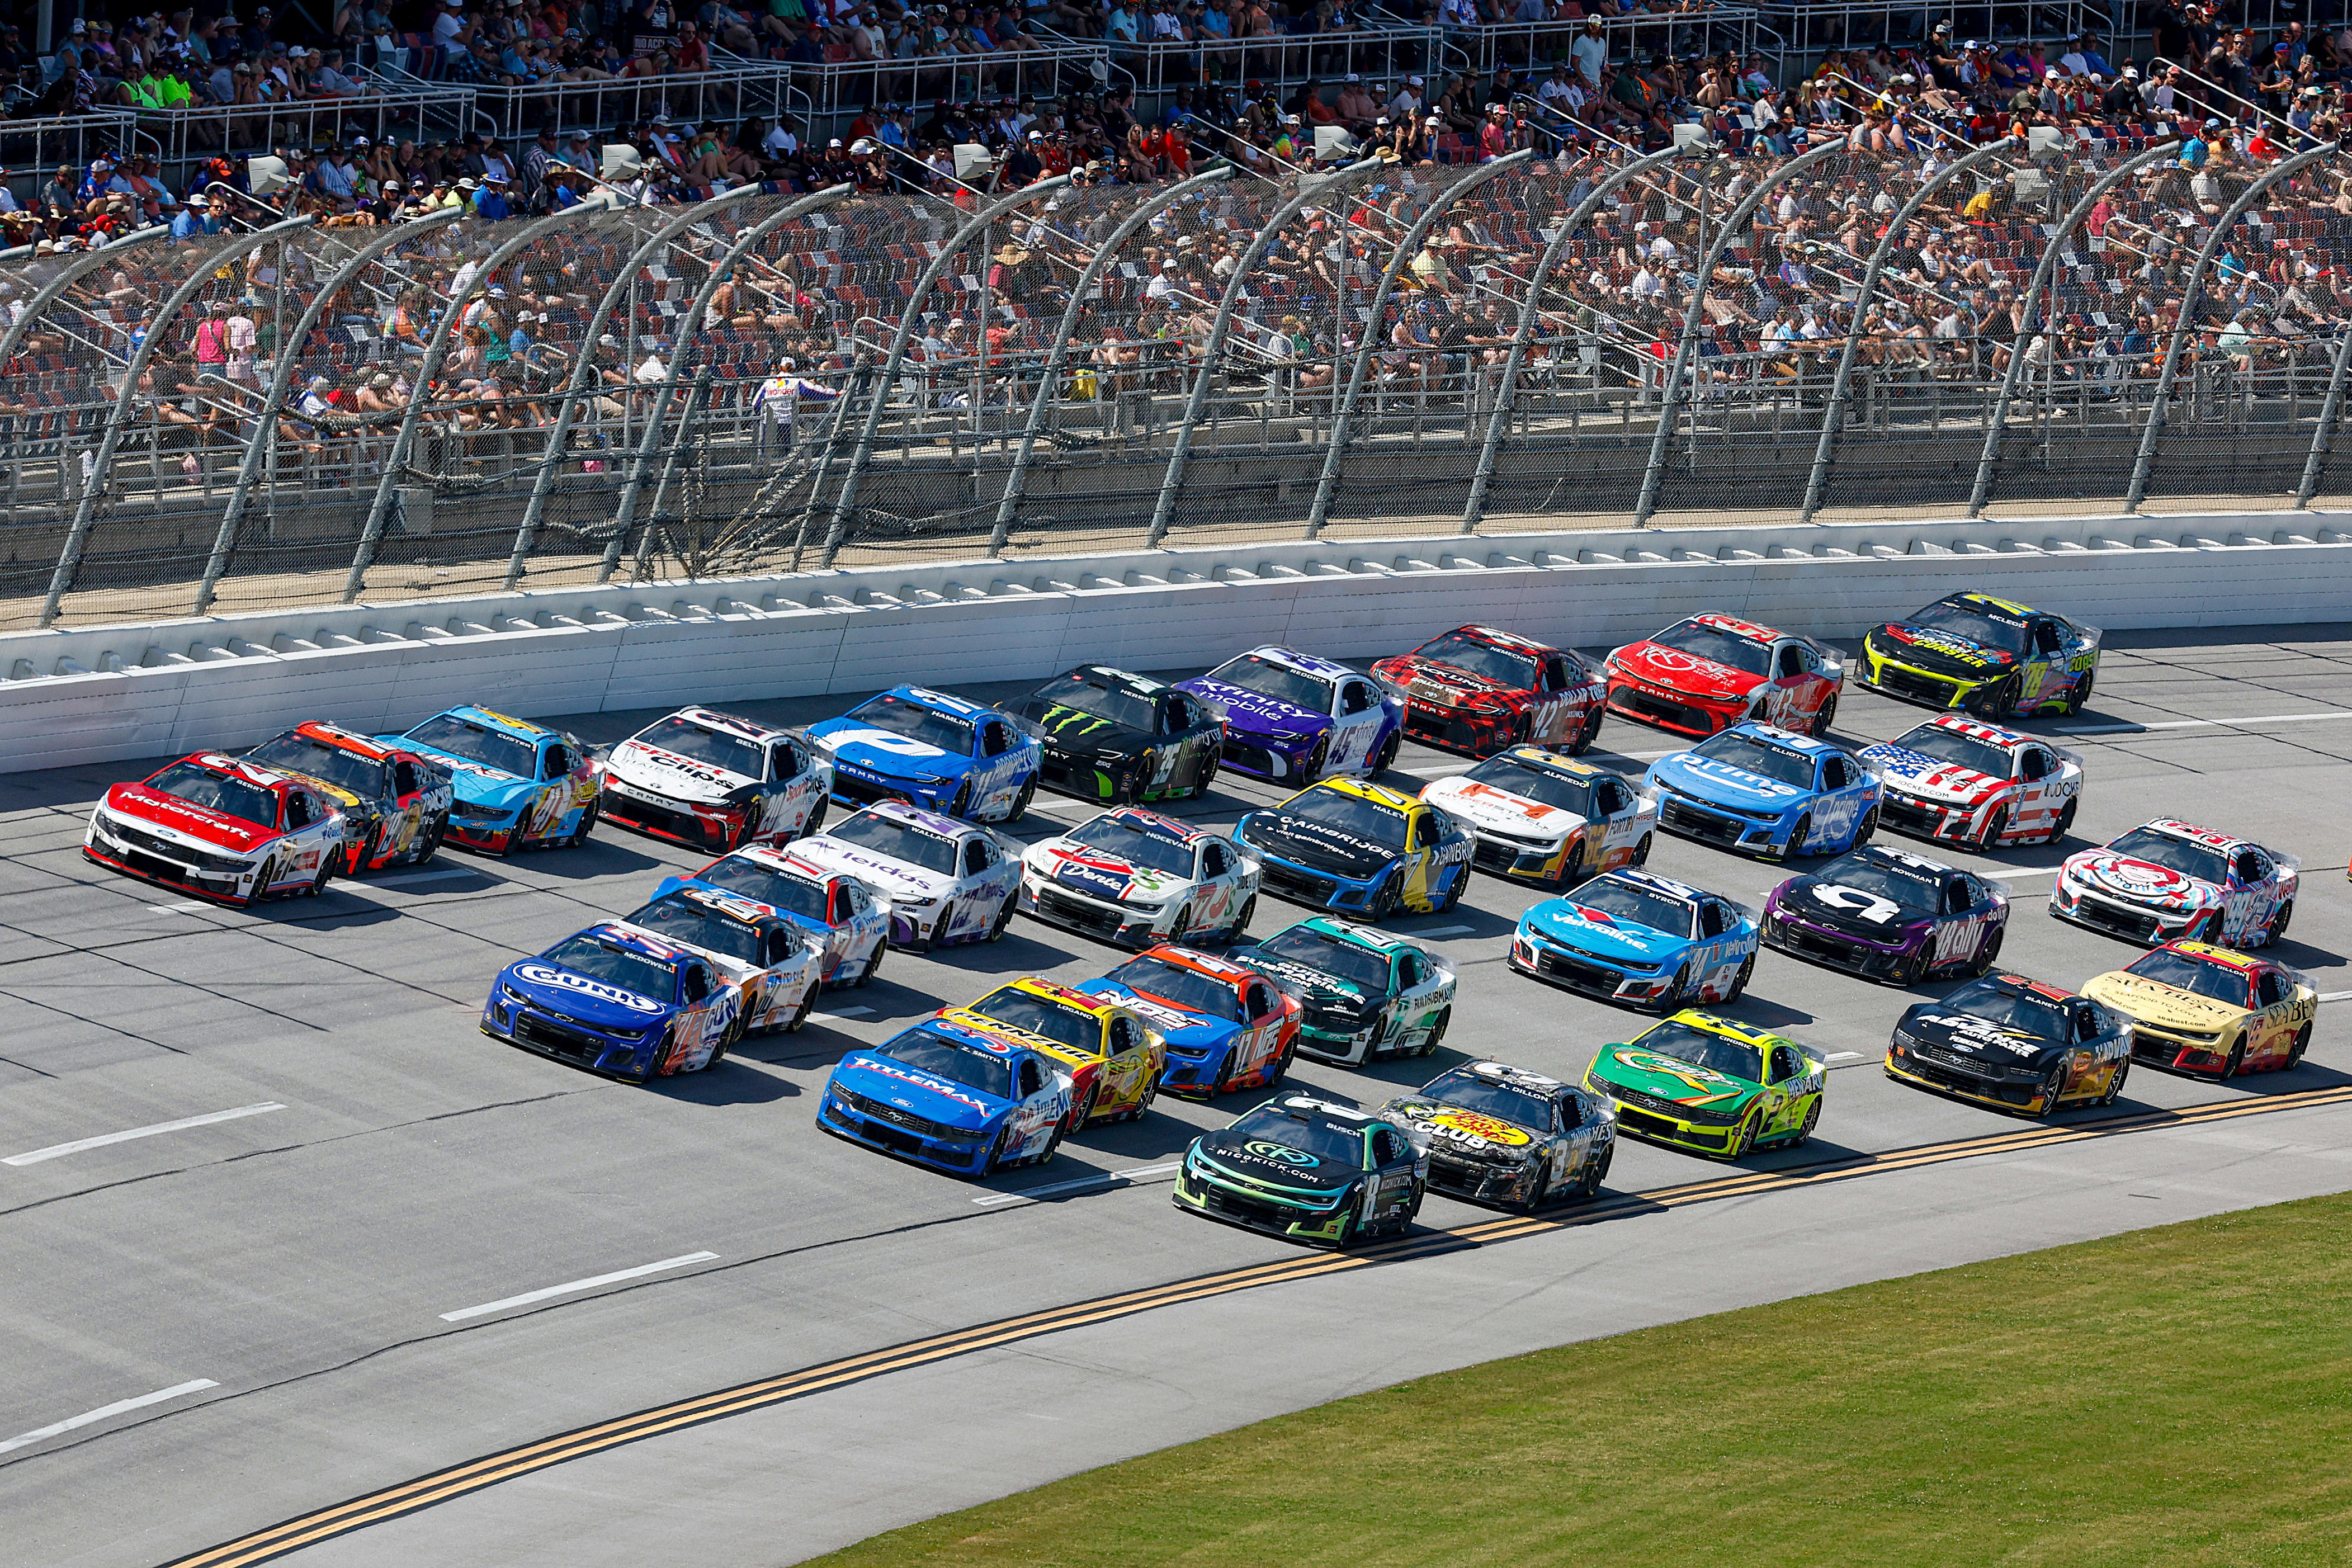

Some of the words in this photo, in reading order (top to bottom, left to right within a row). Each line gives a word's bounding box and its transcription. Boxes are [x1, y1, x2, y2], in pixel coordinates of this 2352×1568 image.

[1988, 613, 2024, 628] MCLEOD
[1739, 639, 1769, 651] JONES
[1913, 639, 1987, 668] COASTER
[1490, 646, 1534, 664] NEMECHEK
[1290, 668, 1326, 684] REDDICK
[1409, 664, 1444, 677] JACK
[1411, 677, 1444, 689] DOLLAR
[1120, 689, 1155, 703] HERBST
[1558, 687, 1588, 708] DOLLAR
[1587, 683, 1606, 701] TREE
[1639, 686, 1684, 702] CAMRY
[1199, 691, 1282, 720] mobile
[1404, 699, 1448, 716] CAMRY
[931, 710, 969, 727] HAMLIN
[1533, 702, 1558, 738] 42
[497, 733, 531, 748] CUSTER
[735, 738, 759, 750] BELL
[1191, 728, 1221, 749] MONSTER
[1966, 735, 2013, 755] CHASTAIN
[338, 748, 381, 767] BRISCOE
[625, 742, 728, 776] Sport
[1772, 747, 1807, 761] ELLIOTT
[839, 764, 886, 783] CAMRY
[1543, 770, 1587, 788] ALFREDO
[1671, 753, 1798, 796] prime
[236, 780, 266, 793] BERRY
[1896, 777, 1949, 799] JOCKEY.COM
[2055, 782, 2079, 797] JOCKE
[627, 788, 674, 806] CAMRY
[1373, 805, 1405, 819] HALEY
[1832, 797, 1859, 820] prime
[911, 826, 952, 843] WALLACE
[1146, 831, 1191, 850] HOCEVAR
[1276, 828, 1295, 838] visit
[1295, 834, 1356, 859] gainbridge.io
[1279, 816, 1396, 859] GAINBRIDGE
[2189, 841, 2227, 857] SUÁREZ
[778, 871, 826, 890] BUESCHER
[842, 852, 932, 891] leidos
[1064, 863, 1123, 890] Dente
[1891, 867, 1933, 884] BOWMAN
[1649, 892, 1680, 906] BYRON
[1773, 911, 1781, 920] 48
[721, 918, 753, 933] PREECE
[1552, 913, 1649, 951] Valvoline
[1339, 940, 1386, 960] KESELOWSKI
[624, 951, 673, 972] MCDOWELL
[1186, 969, 1228, 986] STENHOUSE
[1235, 955, 1366, 1004] SUBMARINES
[2217, 965, 2245, 977] DILLON
[521, 965, 660, 1011] GUNK
[2105, 976, 2155, 991] SEA
[2164, 990, 2233, 1017] BEST
[2025, 995, 2058, 1009] BLANEY
[2099, 991, 2137, 1011] seabest.com
[2114, 989, 2159, 1004] SEAFOOD
[2174, 1007, 2198, 1018] LOVE
[1057, 1003, 1093, 1021] LOGANO
[2157, 1014, 2207, 1027] seabest.com
[2266, 1003, 2290, 1029] SEA
[2290, 1000, 2316, 1022] BES
[1719, 1035, 1753, 1050] CINDRIC
[1916, 1014, 2041, 1054] ADVANCE
[1949, 1036, 1986, 1050] PENNZOIL
[1958, 1030, 1991, 1043] AUTO
[1992, 1040, 2029, 1058] PARTS
[972, 1050, 1000, 1064] SMITH
[854, 1056, 989, 1117] TITLEMAX
[1512, 1087, 1548, 1102] DILLON
[835, 1102, 843, 1111] 38
[1326, 1122, 1361, 1137] BUSCH
[1414, 1121, 1488, 1150] CLUB
[1447, 1118, 1510, 1144] Shops
[1217, 1148, 1319, 1183] NICOKICK.COM
[1551, 1139, 1567, 1182] 3
[1191, 1169, 1198, 1180] 8
[1362, 1174, 1381, 1222] 8
